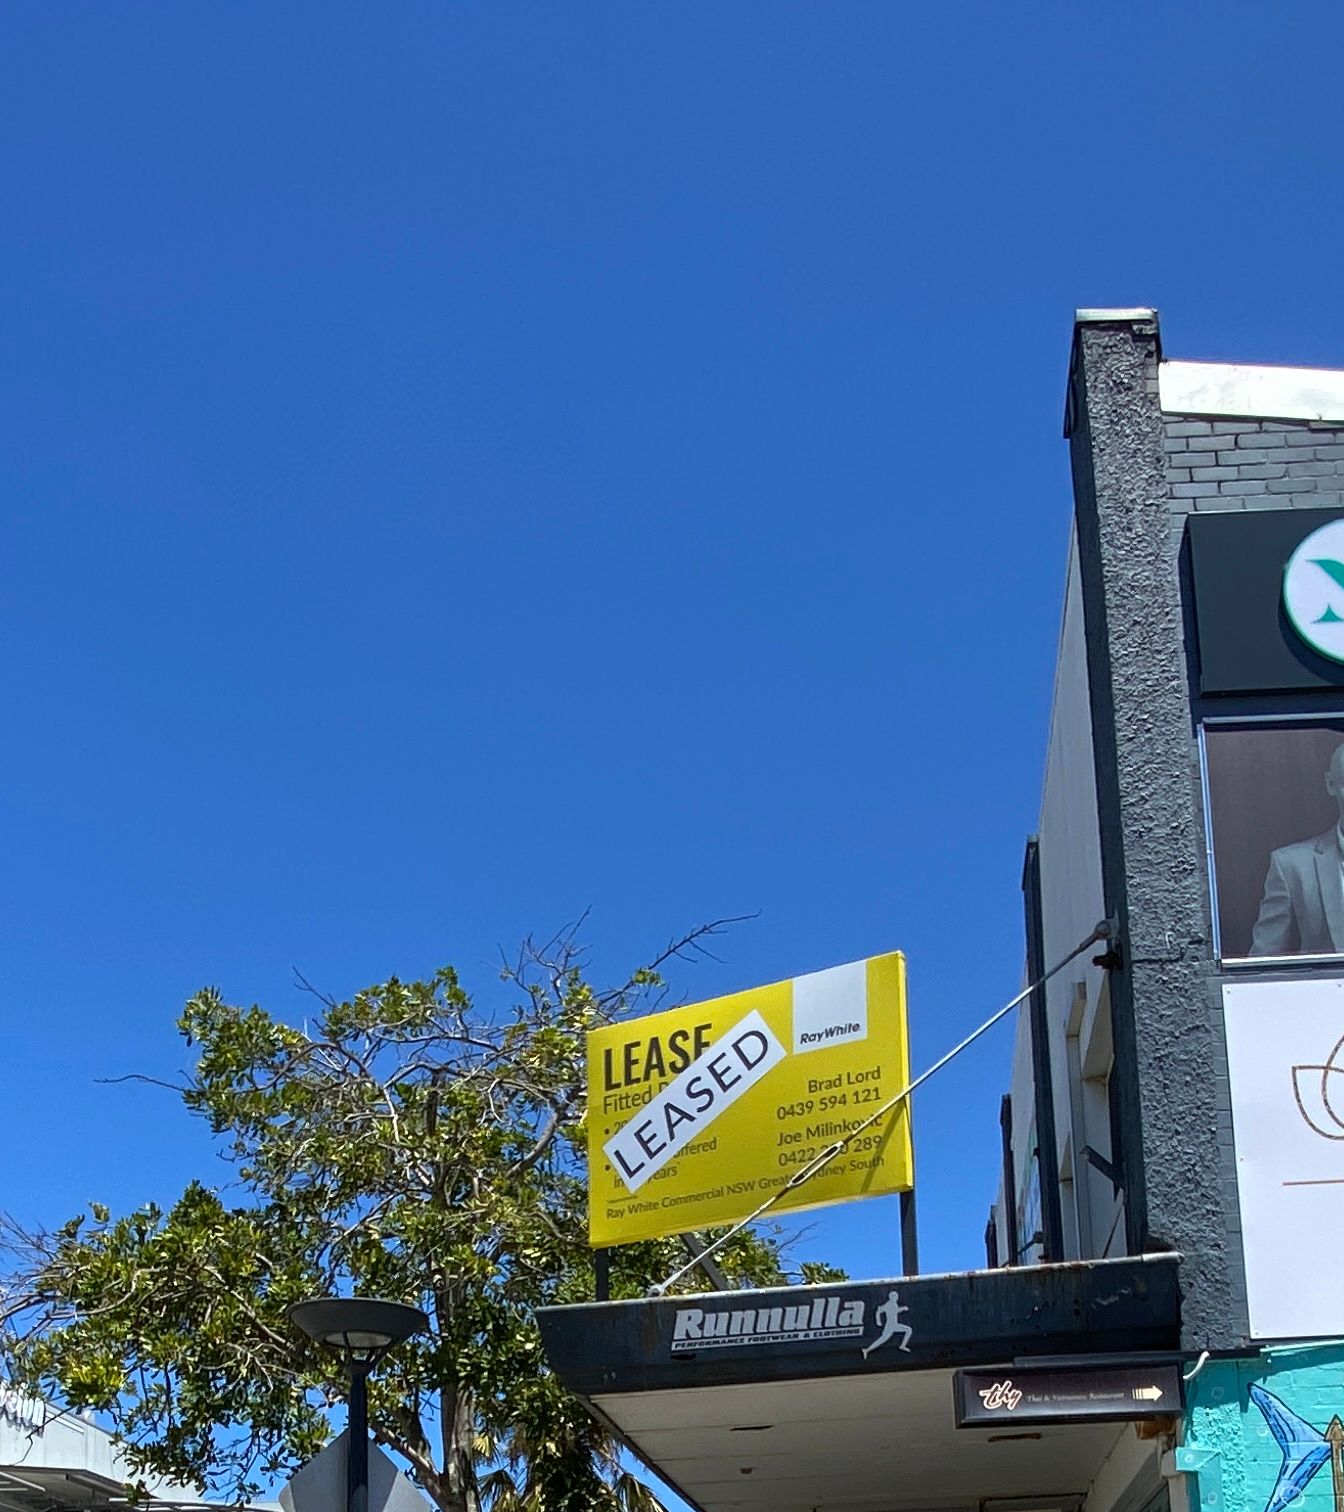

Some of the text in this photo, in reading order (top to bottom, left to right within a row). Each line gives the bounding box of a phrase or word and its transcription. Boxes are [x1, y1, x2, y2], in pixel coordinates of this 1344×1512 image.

[604, 1023, 713, 1092] LEASE
[808, 1066, 881, 1094] Brad Lord
[603, 1084, 652, 1115] Fitted
[613, 1030, 768, 1180] LEASED
[777, 1087, 881, 1120] 0439 594 121
[777, 1131, 802, 1147] Joe
[779, 1146, 817, 1166] 0422
[854, 1135, 883, 1154] 289
[607, 1207, 625, 1220] Ray
[627, 1200, 659, 1215] White
[662, 1186, 724, 1208] Commercial
[727, 1181, 755, 1196] NSW
[849, 1155, 884, 1171] South
[673, 1296, 866, 1340] Runnulla
[674, 1337, 746, 1349] PERFORMANCE
[747, 1333, 800, 1343] FOOTWEAR
[813, 1328, 861, 1338] CLOTHING
